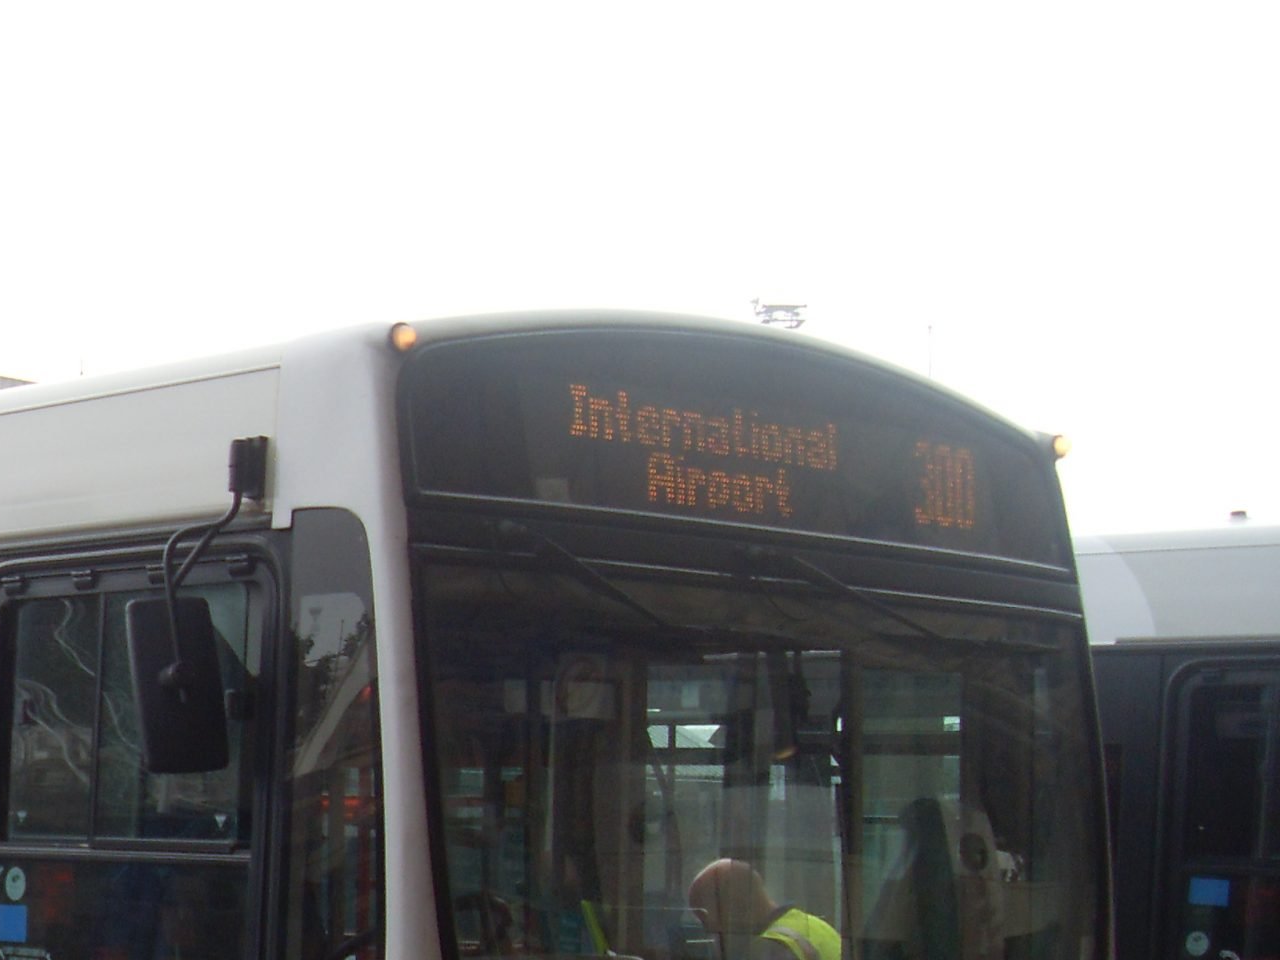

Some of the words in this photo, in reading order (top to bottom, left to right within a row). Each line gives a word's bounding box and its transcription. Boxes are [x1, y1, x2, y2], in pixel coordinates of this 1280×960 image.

[569, 384, 839, 472] International
[647, 453, 794, 518] Airport
[914, 440, 976, 529] 300
